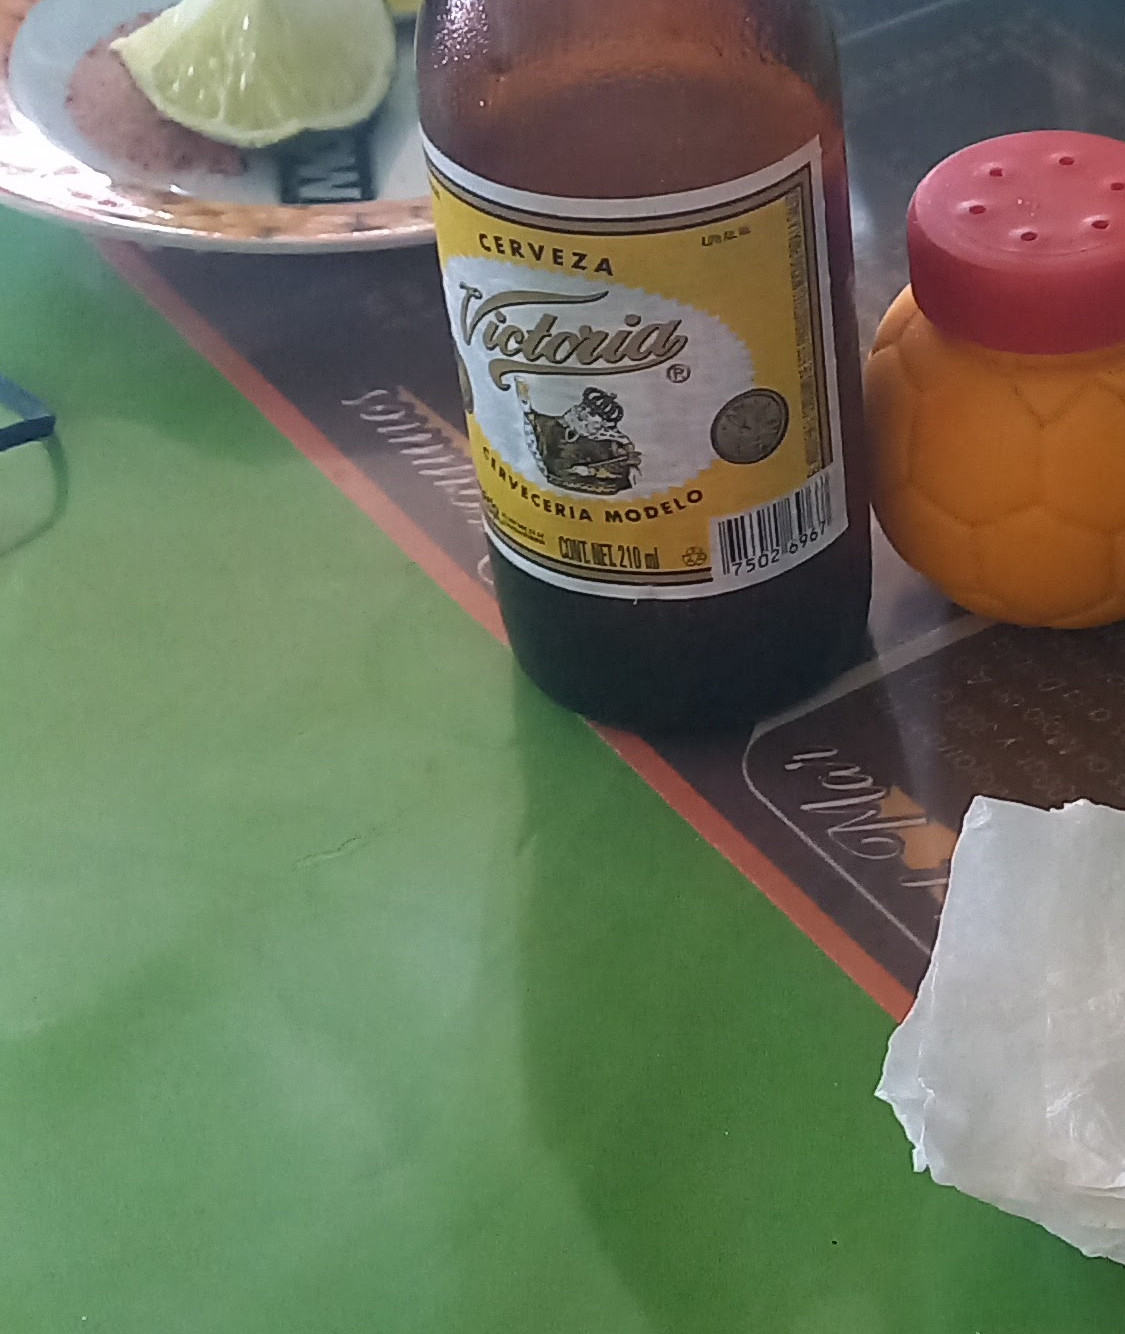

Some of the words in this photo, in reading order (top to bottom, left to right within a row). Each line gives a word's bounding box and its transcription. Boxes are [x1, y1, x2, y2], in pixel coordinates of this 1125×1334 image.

[478, 233, 614, 276] CERVEZA
[459, 282, 688, 373] Victoria
[482, 446, 593, 523] CERVECERIA
[605, 489, 703, 524] MODELO
[617, 544, 641, 569] 210
[732, 550, 780, 576] 7502
